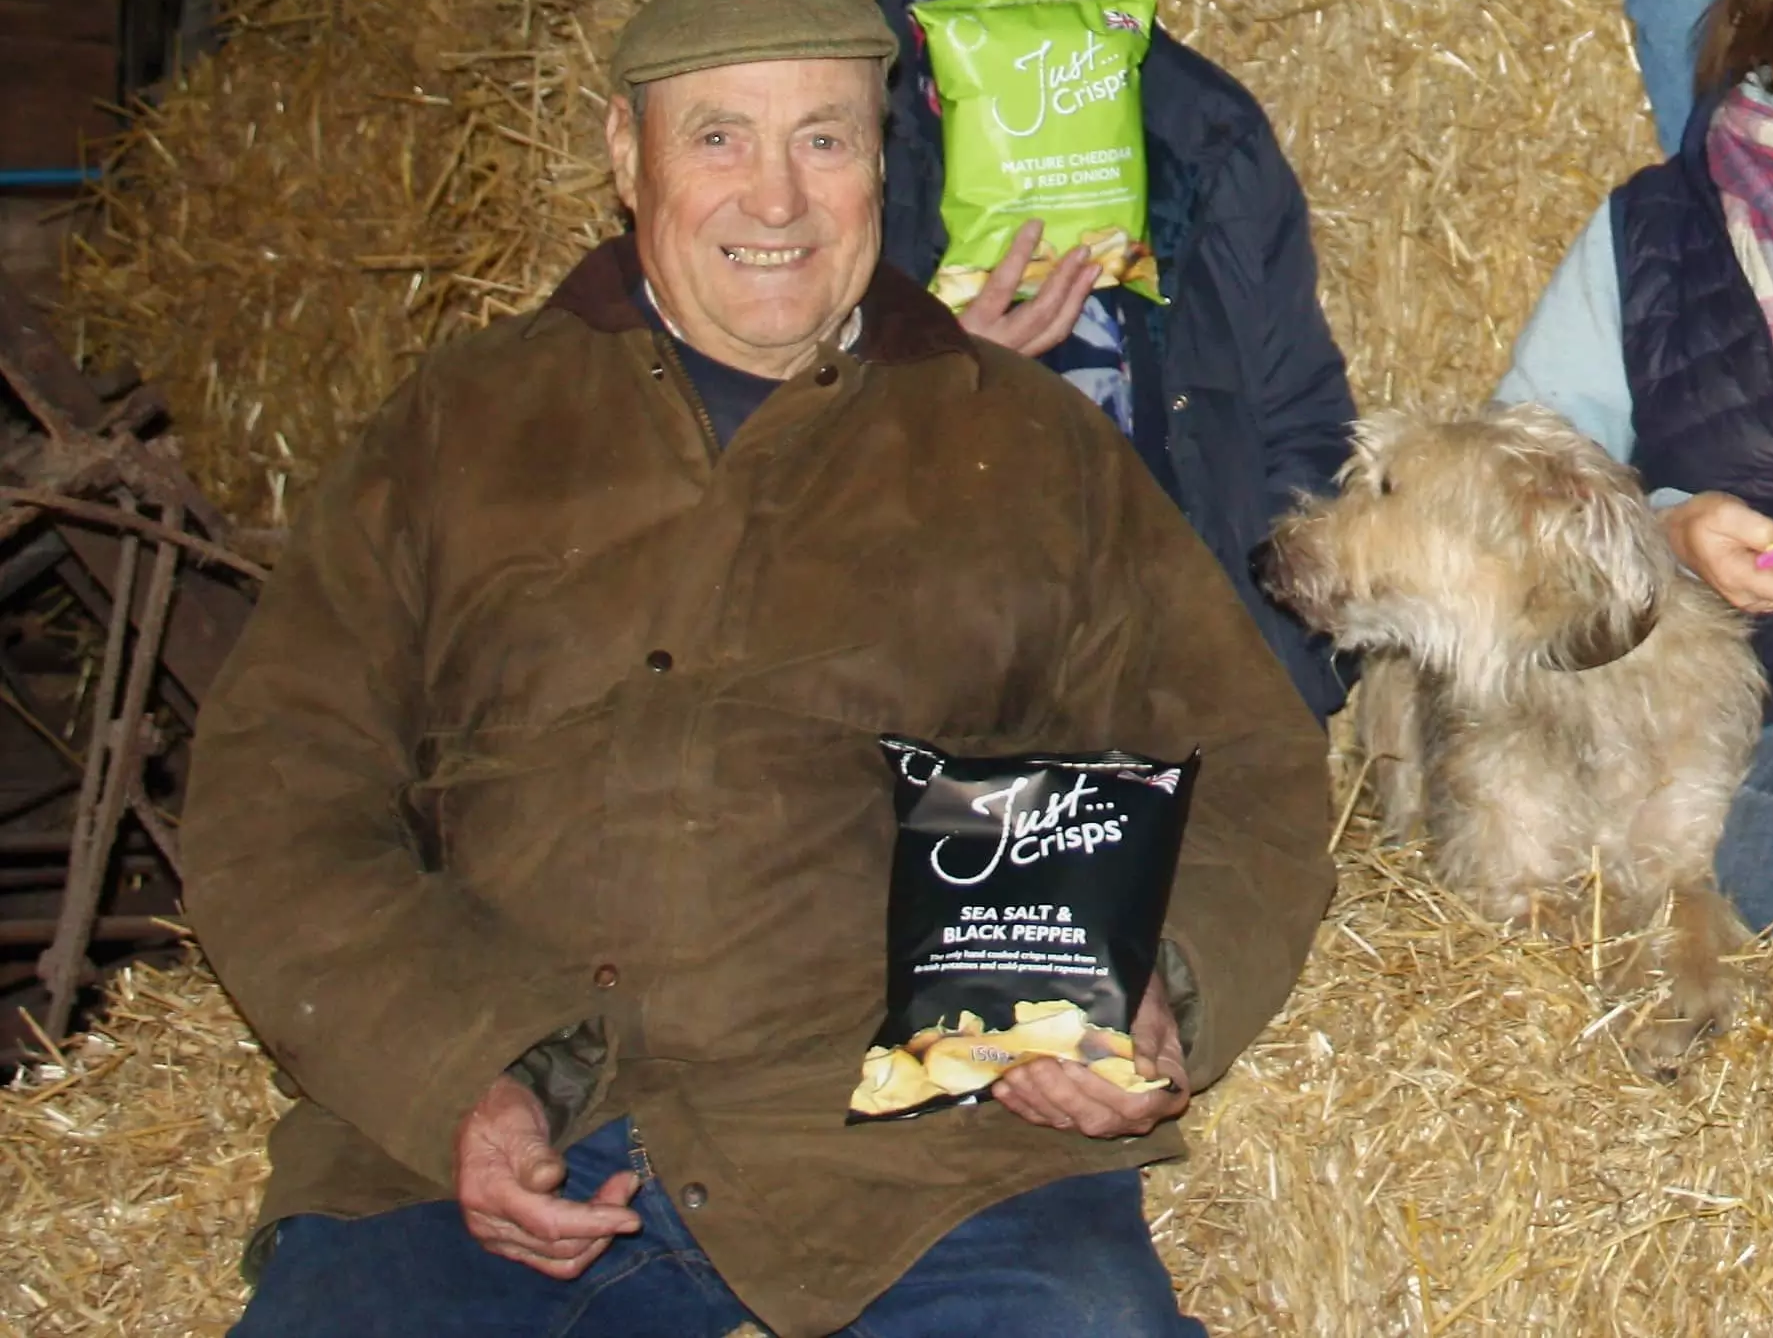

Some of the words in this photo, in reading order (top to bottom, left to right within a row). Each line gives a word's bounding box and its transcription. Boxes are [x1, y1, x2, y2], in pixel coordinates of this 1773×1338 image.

[1001, 155, 1066, 174] MATURE
[1038, 173, 1067, 188] RED
[1072, 167, 1121, 184] ONION
[1010, 819, 1122, 864] Crisps
[960, 905, 998, 921] SEA
[1003, 904, 1053, 921] SALT
[1056, 906, 1072, 922] &
[943, 925, 1007, 944] BLACK
[1011, 925, 1086, 944] PEPPER
